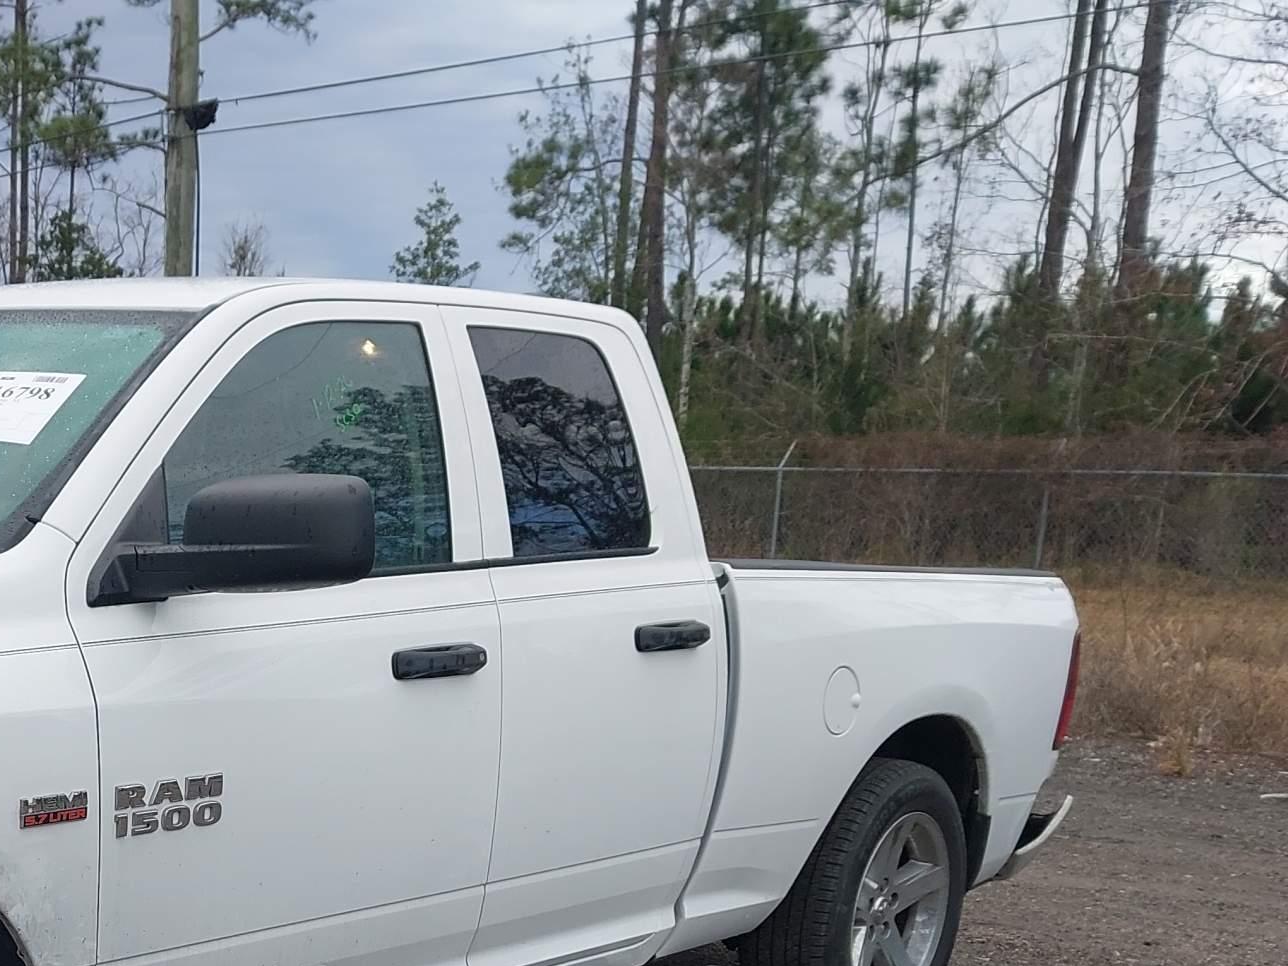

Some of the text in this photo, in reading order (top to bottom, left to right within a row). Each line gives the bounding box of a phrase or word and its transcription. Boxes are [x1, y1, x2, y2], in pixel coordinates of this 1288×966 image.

[20, 790, 88, 815] HEMI
[115, 772, 223, 811] RAM
[25, 808, 86, 827] 5.7 LITER
[114, 801, 222, 839] 1500
